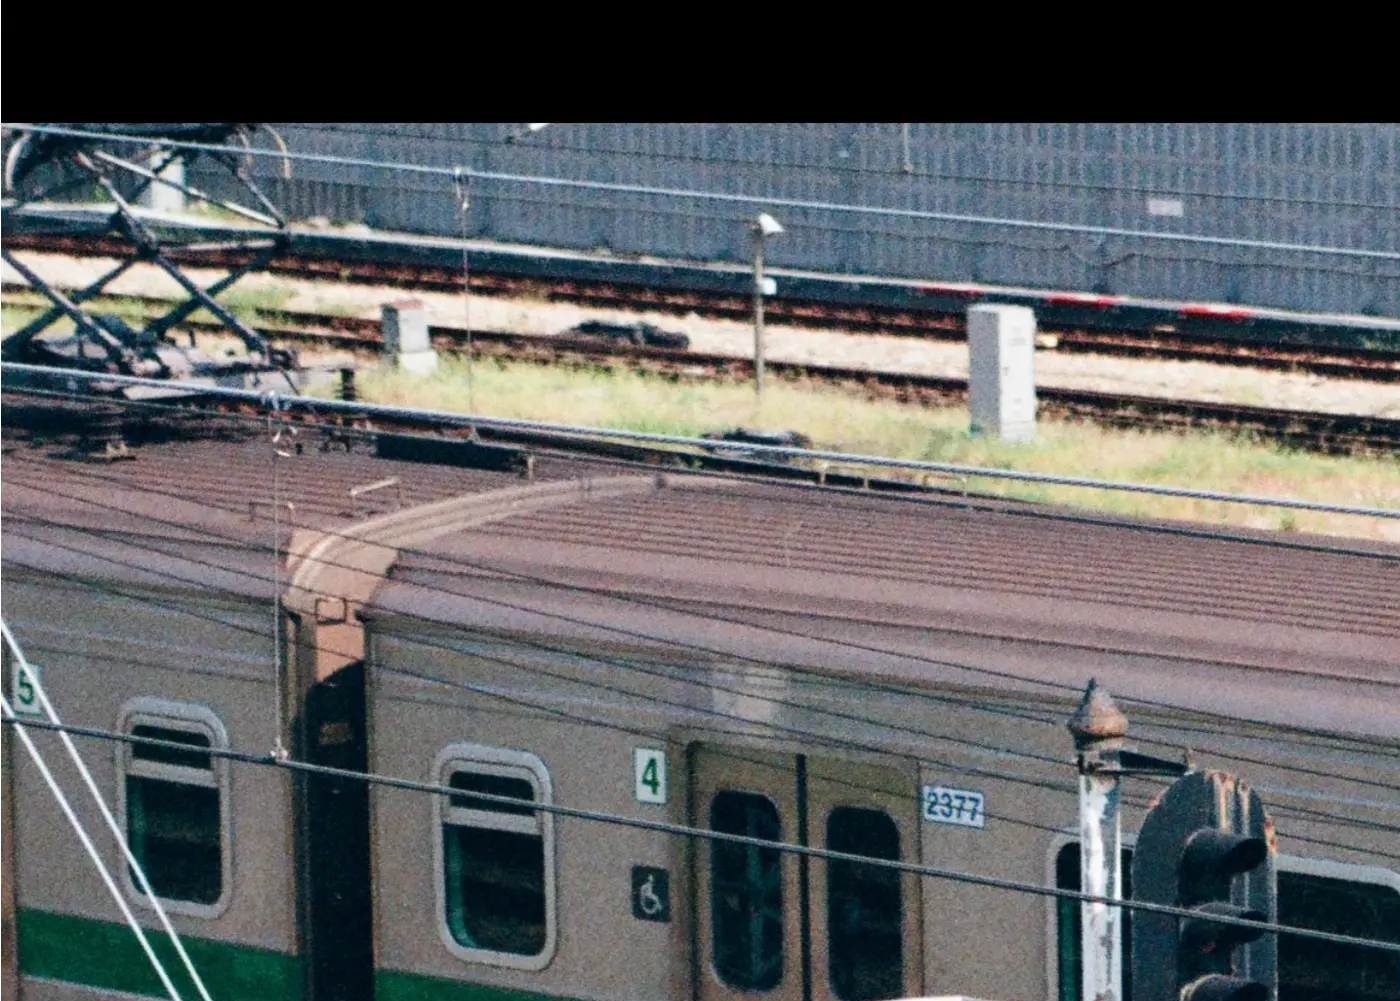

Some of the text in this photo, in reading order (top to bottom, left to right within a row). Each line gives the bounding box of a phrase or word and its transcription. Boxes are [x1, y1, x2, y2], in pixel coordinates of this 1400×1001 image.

[18, 667, 35, 705] 5
[641, 757, 660, 796] 4
[926, 792, 981, 821] 2377
